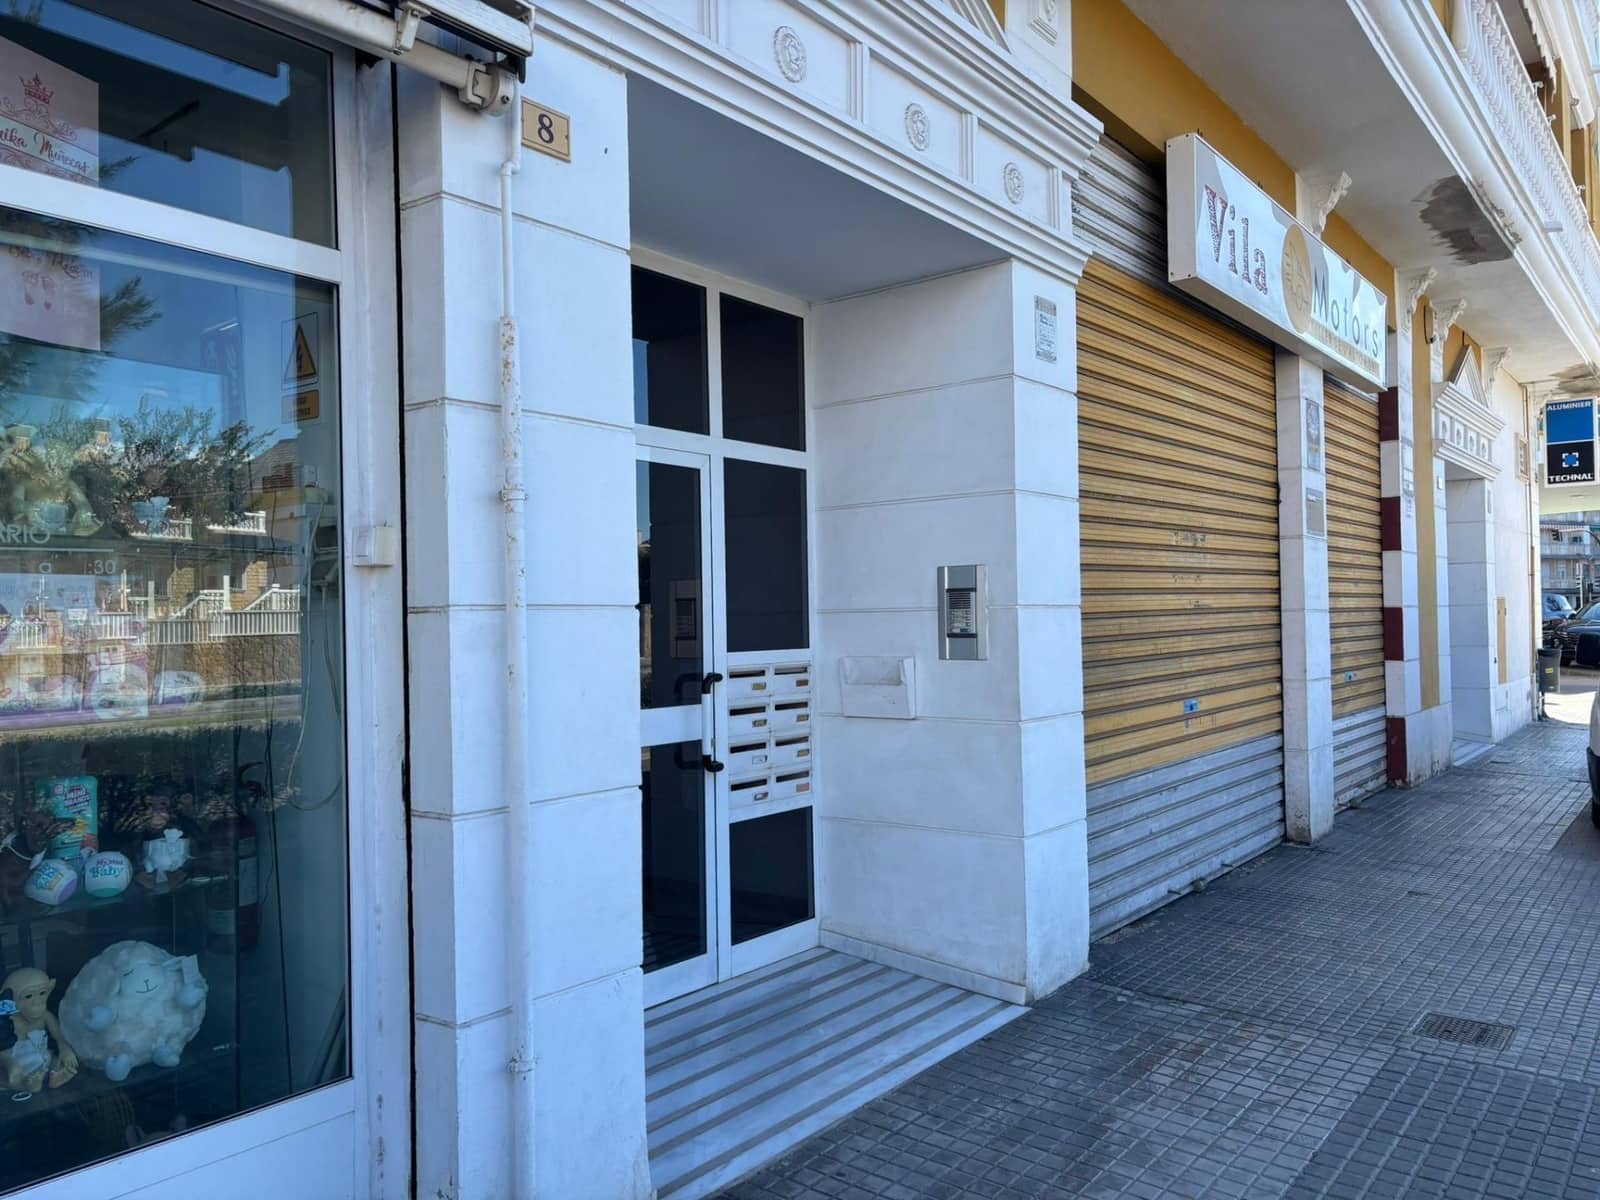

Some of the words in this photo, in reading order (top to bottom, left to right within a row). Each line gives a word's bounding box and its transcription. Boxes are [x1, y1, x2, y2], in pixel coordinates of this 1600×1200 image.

[537, 113, 554, 144] 8
[34, 132, 88, 173] Muñecas
[1204, 184, 1268, 295] Vila
[1313, 271, 1379, 358] Motors
[1547, 400, 1591, 411] ALUMINIER
[1549, 474, 1593, 483] TECHNAL
